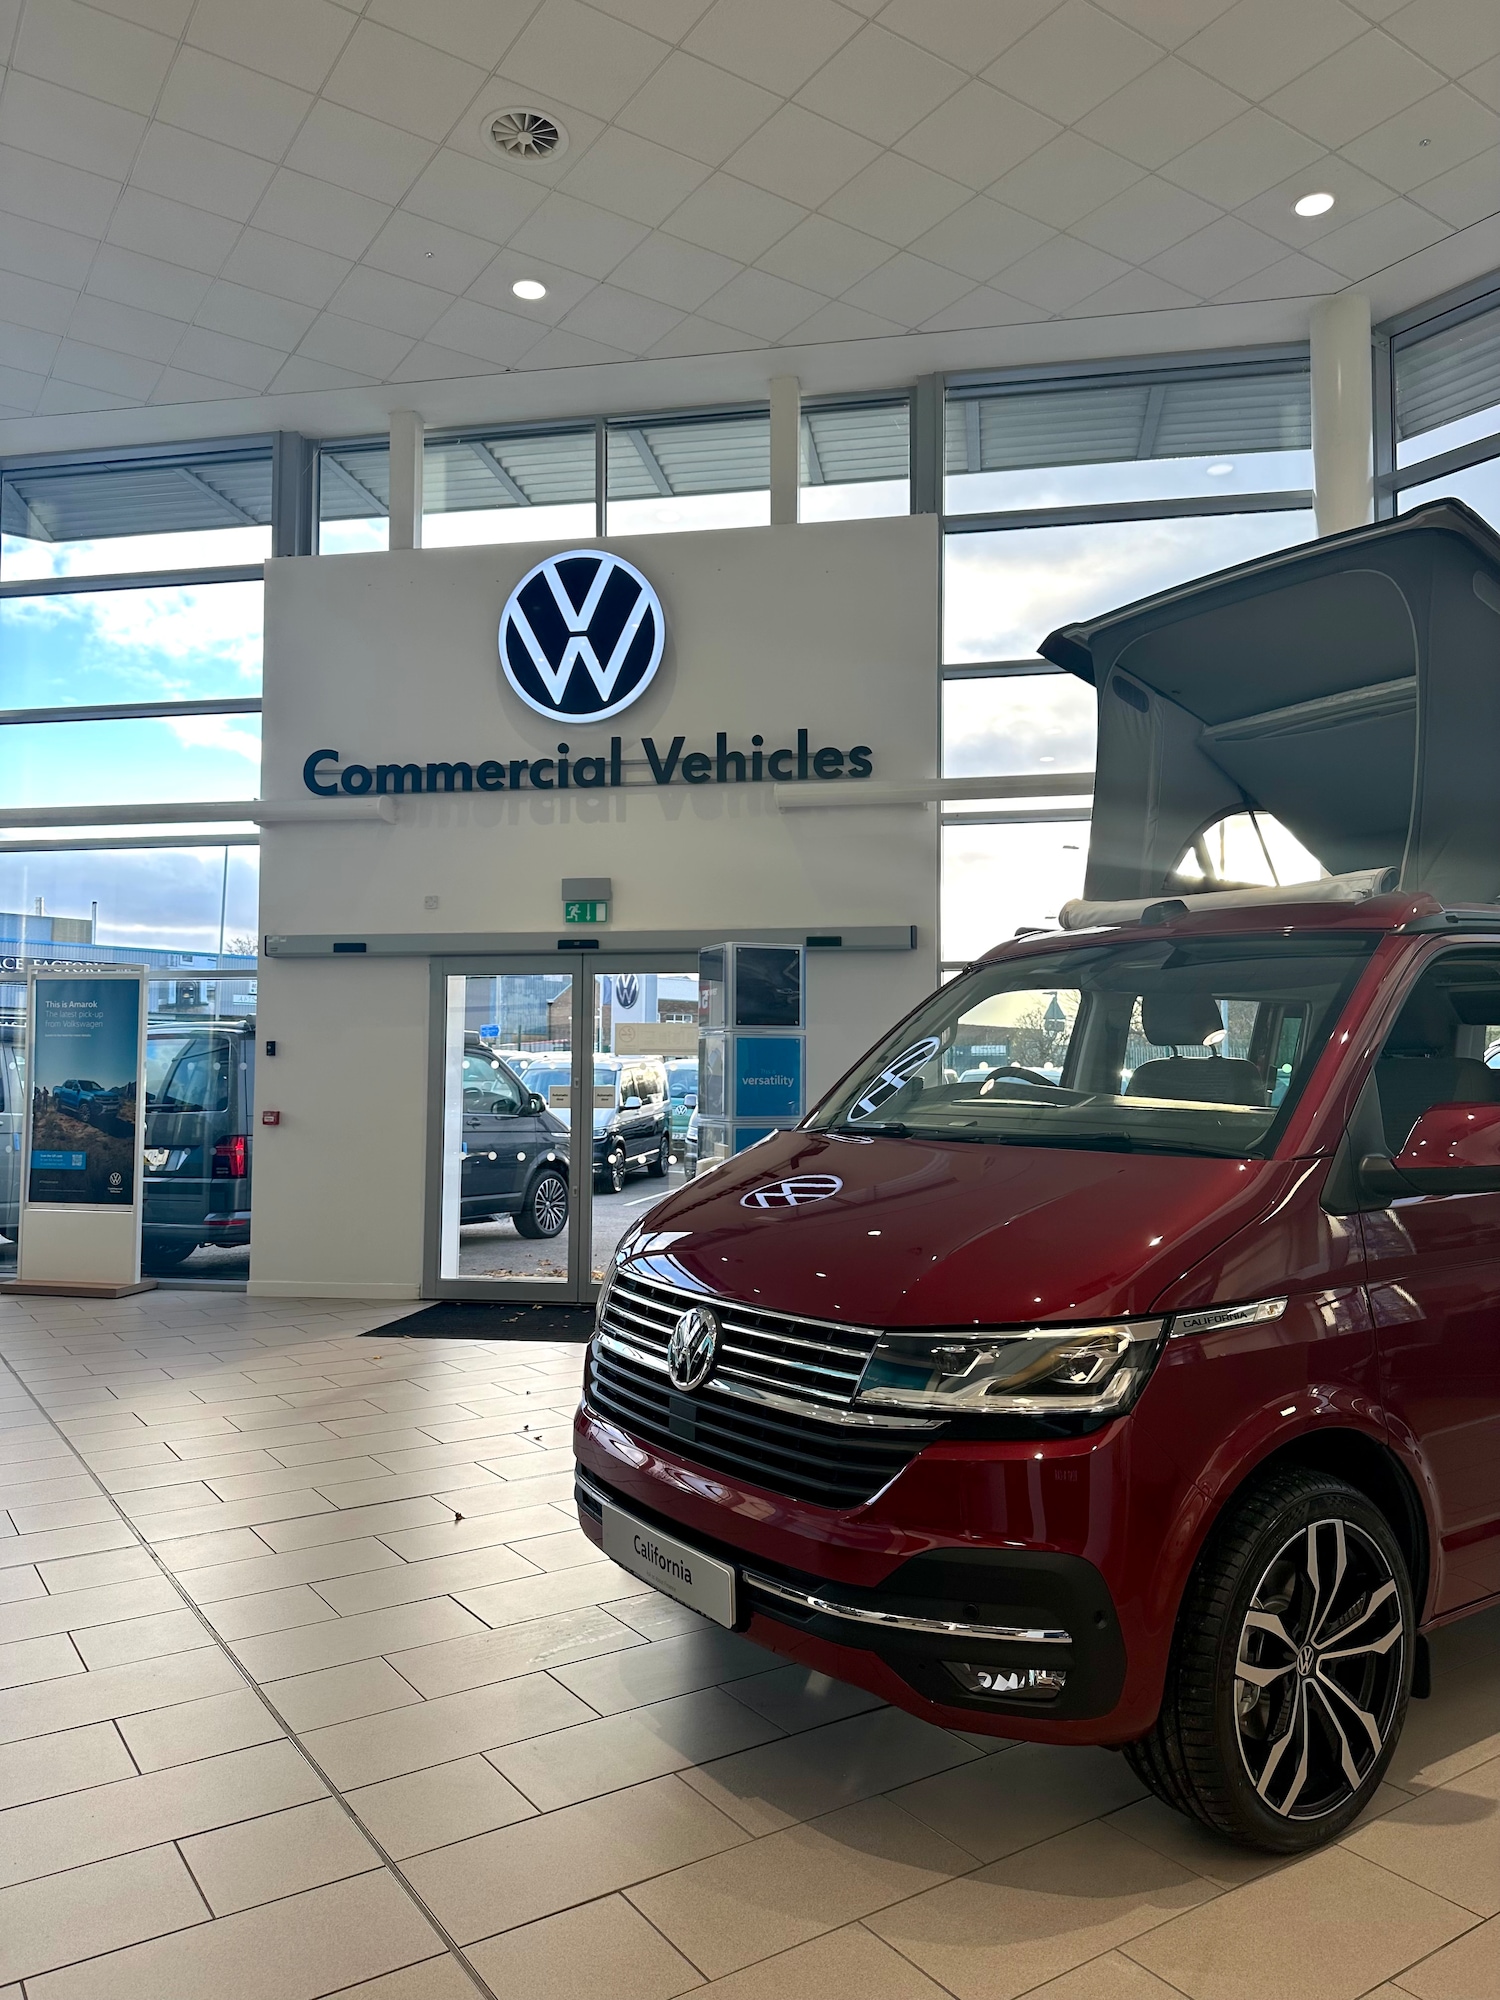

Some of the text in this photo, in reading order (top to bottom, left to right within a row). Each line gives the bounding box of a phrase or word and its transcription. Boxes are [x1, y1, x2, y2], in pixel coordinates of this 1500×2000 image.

[303, 728, 873, 796] Commercial Vehicles
[45, 1010, 104, 1020] The latest pick-up
[63, 1021, 104, 1030] Volkswagen
[742, 1075, 794, 1087] versatility
[1183, 1312, 1247, 1328] CALIFORNIA
[633, 1535, 693, 1585] California
